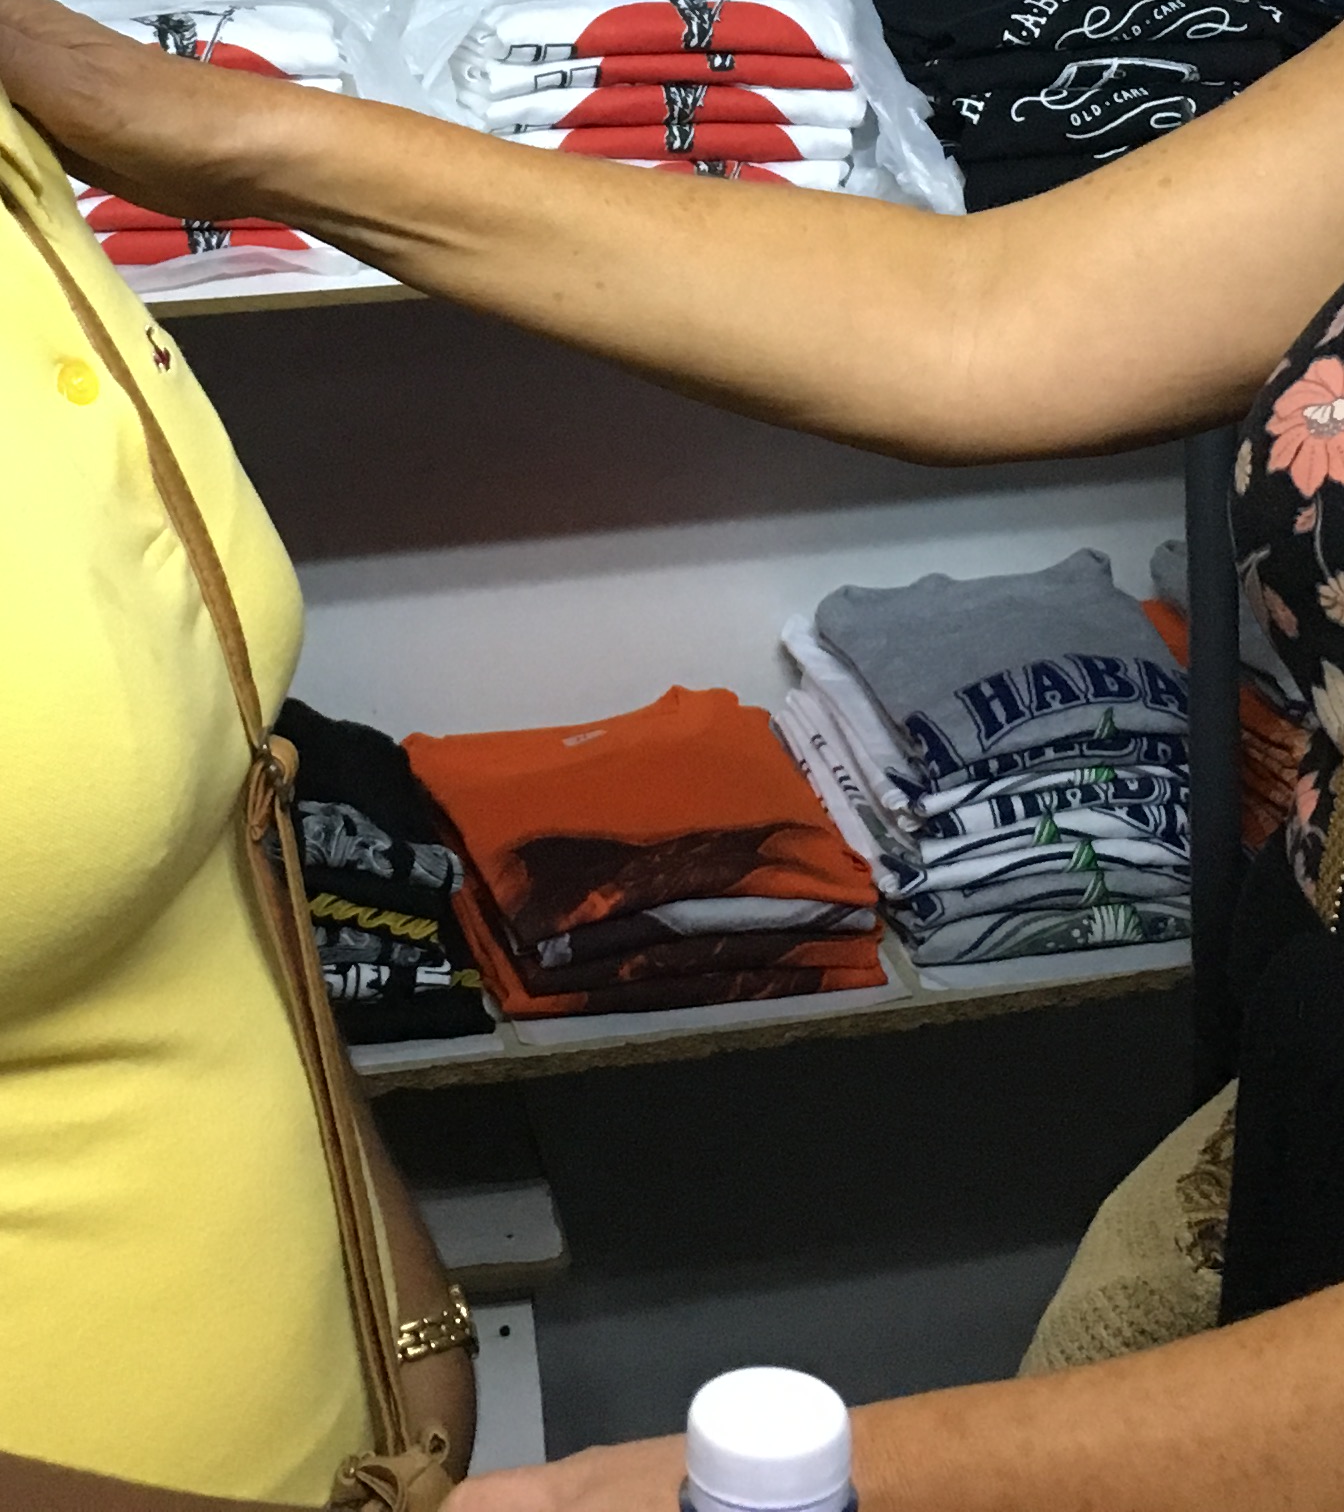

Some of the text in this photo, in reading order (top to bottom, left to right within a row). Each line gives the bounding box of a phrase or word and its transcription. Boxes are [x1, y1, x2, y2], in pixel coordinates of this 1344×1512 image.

[1070, 87, 1149, 127] OLD CARS
[954, 653, 1188, 751] HABA
